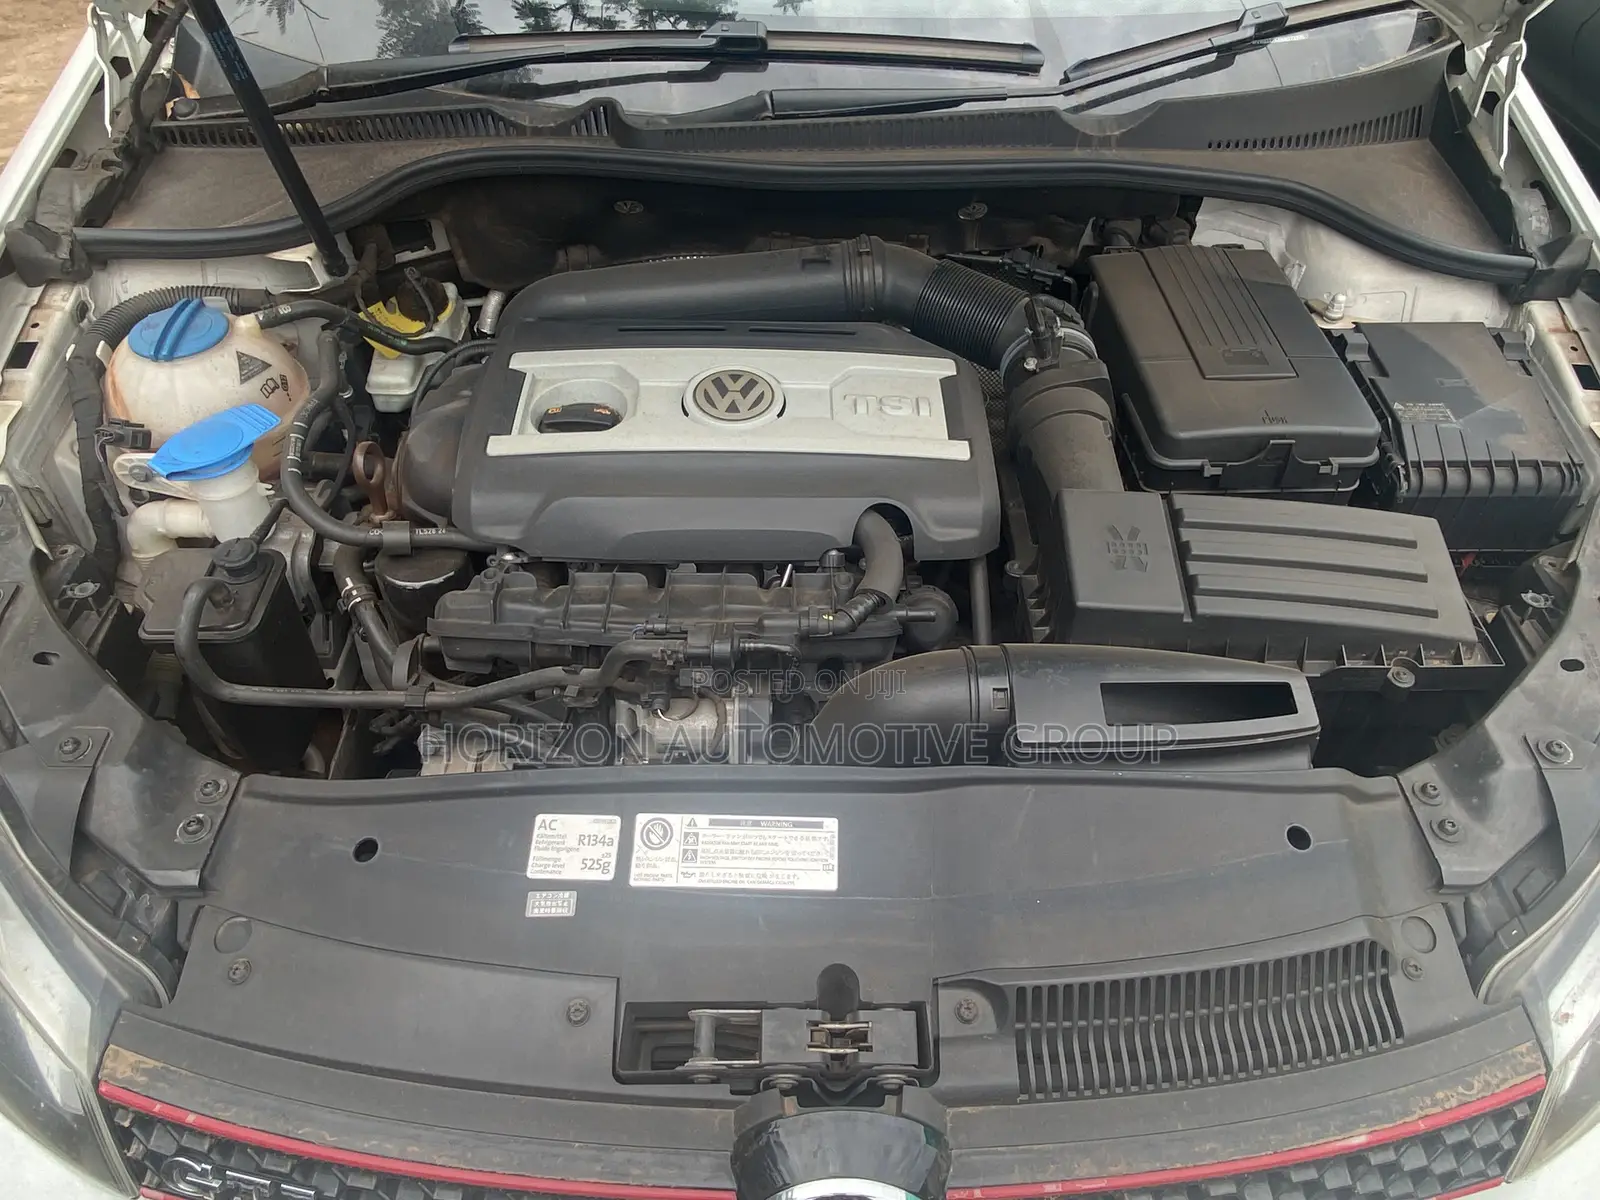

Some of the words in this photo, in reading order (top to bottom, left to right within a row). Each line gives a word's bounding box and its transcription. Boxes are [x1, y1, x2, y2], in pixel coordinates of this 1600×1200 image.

[843, 393, 932, 418] TSI
[537, 818, 558, 831] AC
[760, 820, 793, 828] WARNING
[577, 834, 614, 847] R134a
[580, 858, 612, 875] 525g
